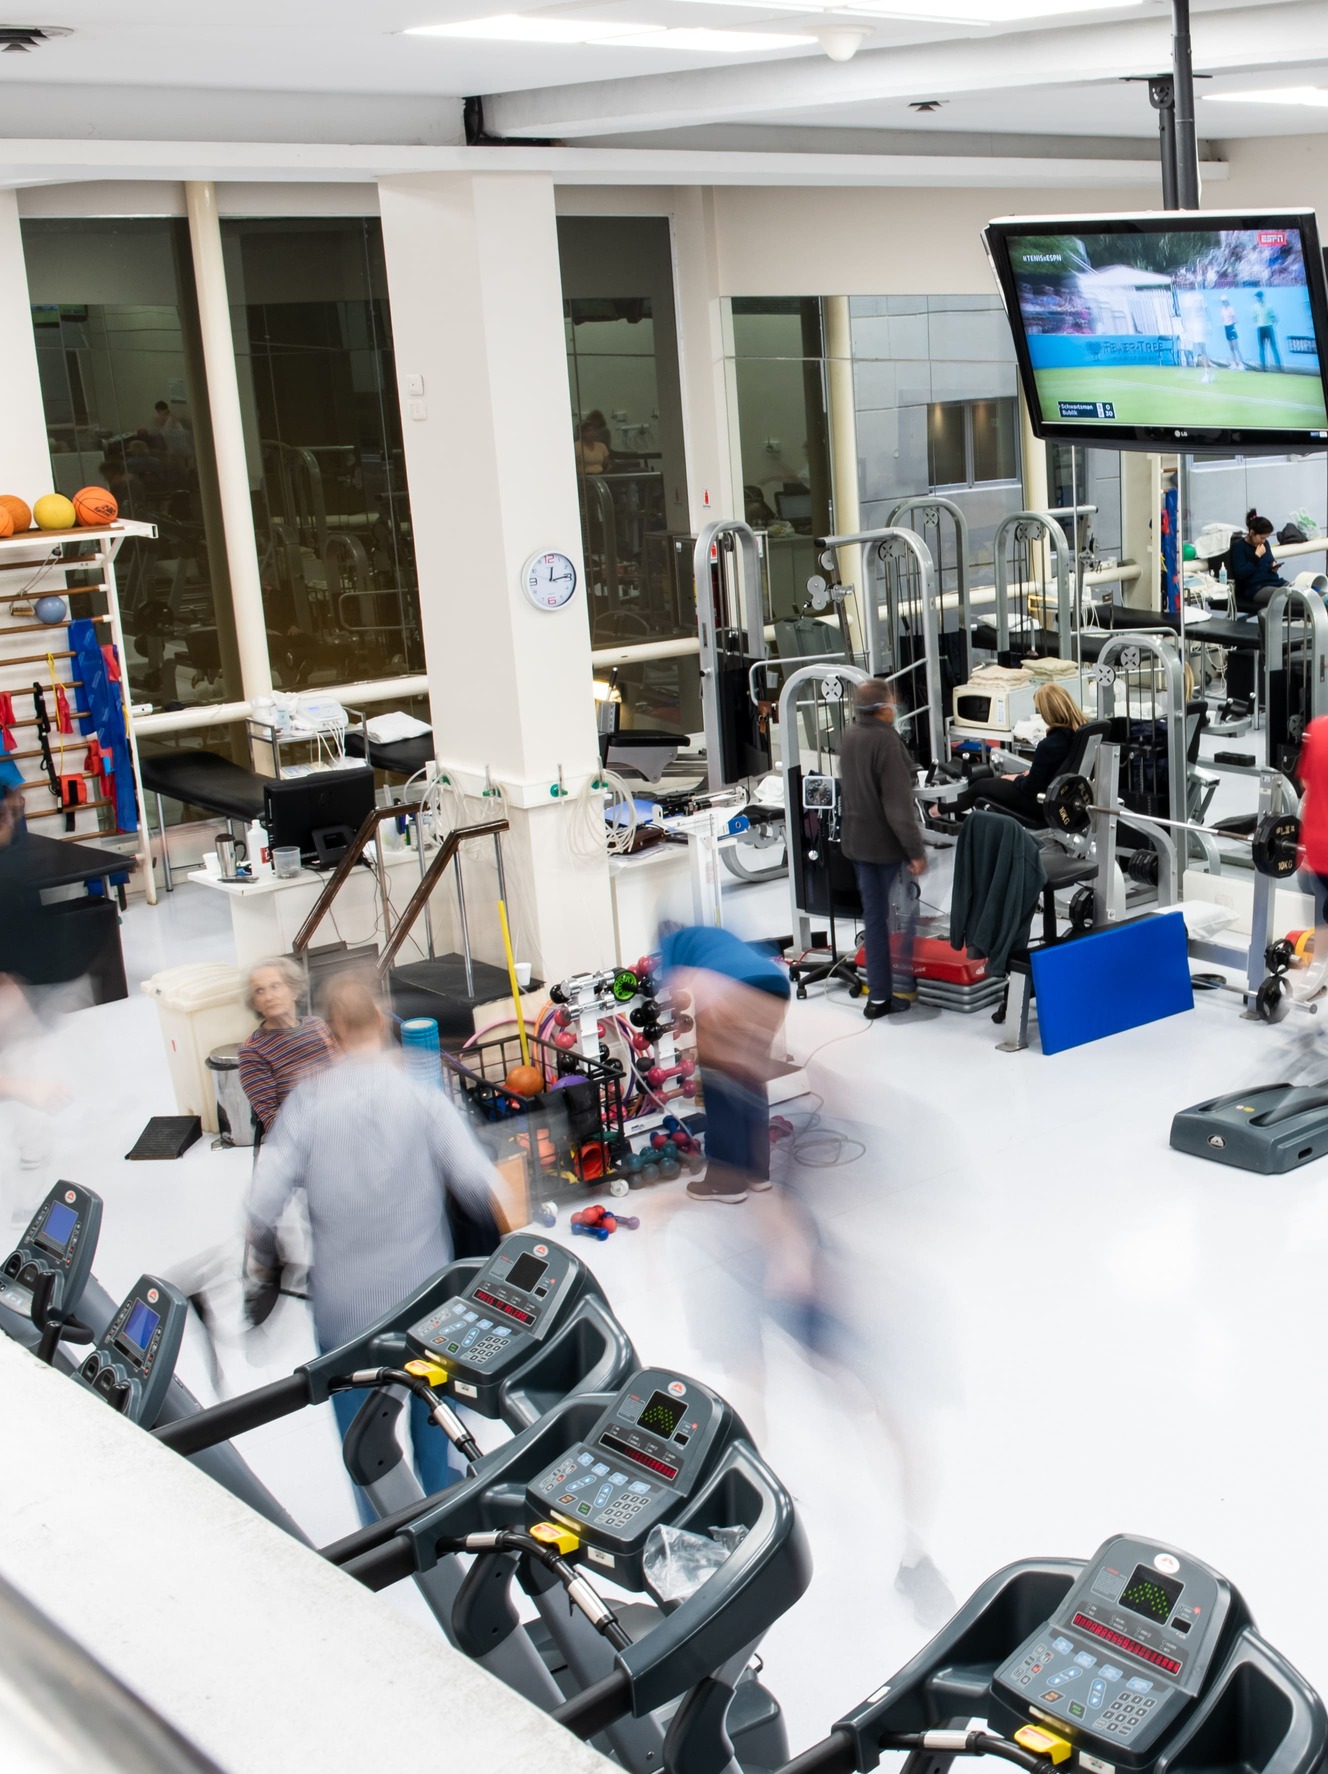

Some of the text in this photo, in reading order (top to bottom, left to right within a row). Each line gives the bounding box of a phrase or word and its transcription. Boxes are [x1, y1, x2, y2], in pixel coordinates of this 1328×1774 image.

[1260, 235, 1284, 243] ESPN
[543, 554, 555, 564] 12
[548, 596, 556, 605] 6
[1278, 860, 1292, 870] 10KG
